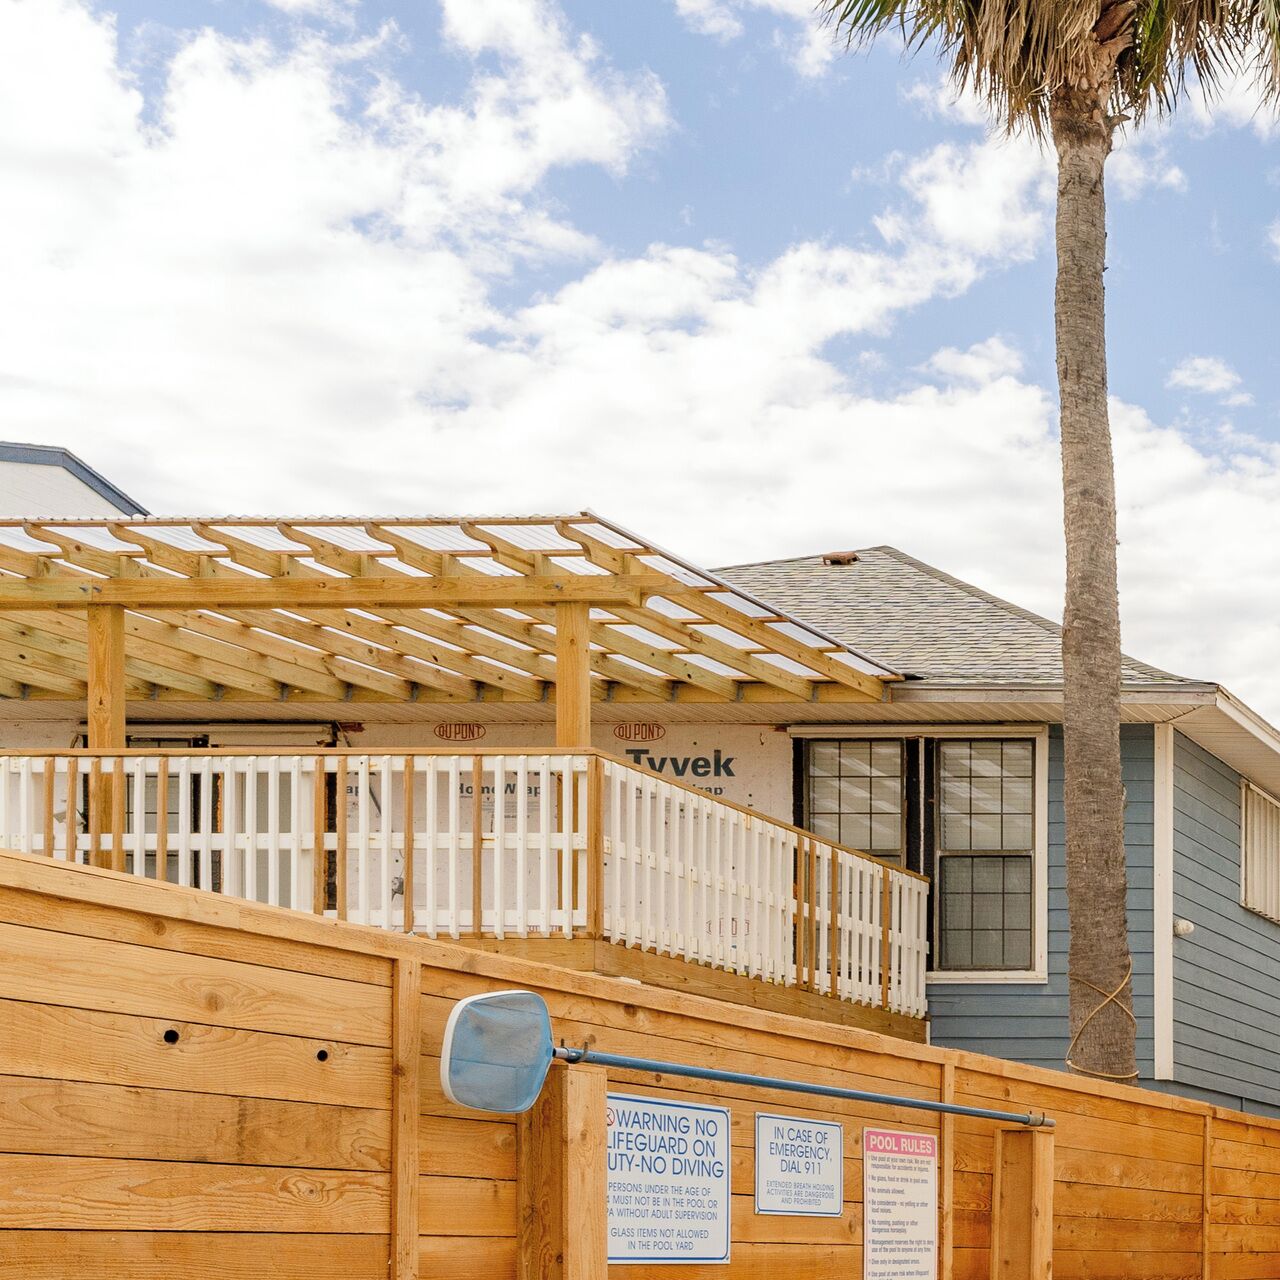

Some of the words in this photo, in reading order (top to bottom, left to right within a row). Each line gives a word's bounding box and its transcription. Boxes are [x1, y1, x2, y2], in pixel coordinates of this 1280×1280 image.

[625, 748, 736, 777] Tyvek
[616, 1109, 690, 1134] WARNING
[696, 1118, 718, 1137] NO
[774, 1126, 784, 1140] IN
[787, 1128, 812, 1143] CASE
[815, 1131, 828, 1144] OF
[607, 1131, 688, 1155] IFEGUARD
[693, 1140, 715, 1158] ON
[770, 1142, 832, 1162] EMERGENCY,
[870, 1135, 898, 1151] POOL
[901, 1138, 932, 1154] RULES
[608, 1152, 666, 1174] UTY-NO
[672, 1157, 724, 1178] DIVING
[781, 1159, 801, 1173] DIAL
[805, 1162, 821, 1175] 911
[608, 1182, 642, 1193] PERSONS
[645, 1184, 669, 1194] UNDER
[671, 1186, 683, 1195] THE
[685, 1186, 699, 1196] AGE
[701, 1188, 711, 1196] OF
[766, 1180, 792, 1188] EXTENDED
[794, 1182, 811, 1190] BREATH
[613, 1195, 632, 1205] MUST
[635, 1196, 649, 1206] NOT
[652, 1197, 660, 1206] BE
[663, 1198, 670, 1207] IN
[673, 1198, 685, 1207] THE
[687, 1199, 706, 1208] POOL
[708, 1200, 718, 1209] OR
[794, 1198, 821, 1206] PROHIBITED
[805, 1191, 834, 1199] DANGEROUS
[616, 1208, 649, 1218] WITHOUT
[651, 1209, 673, 1219] ADULT
[675, 1210, 718, 1221] SUPERVISION
[611, 1228, 634, 1238] GLASS
[637, 1228, 657, 1238] ITEMS
[660, 1229, 675, 1238] NOT
[677, 1230, 709, 1239] ALLOWED
[628, 1241, 636, 1249] IN
[638, 1241, 651, 1250] THE
[653, 1241, 673, 1250] POOL
[675, 1242, 694, 1251] YARD
